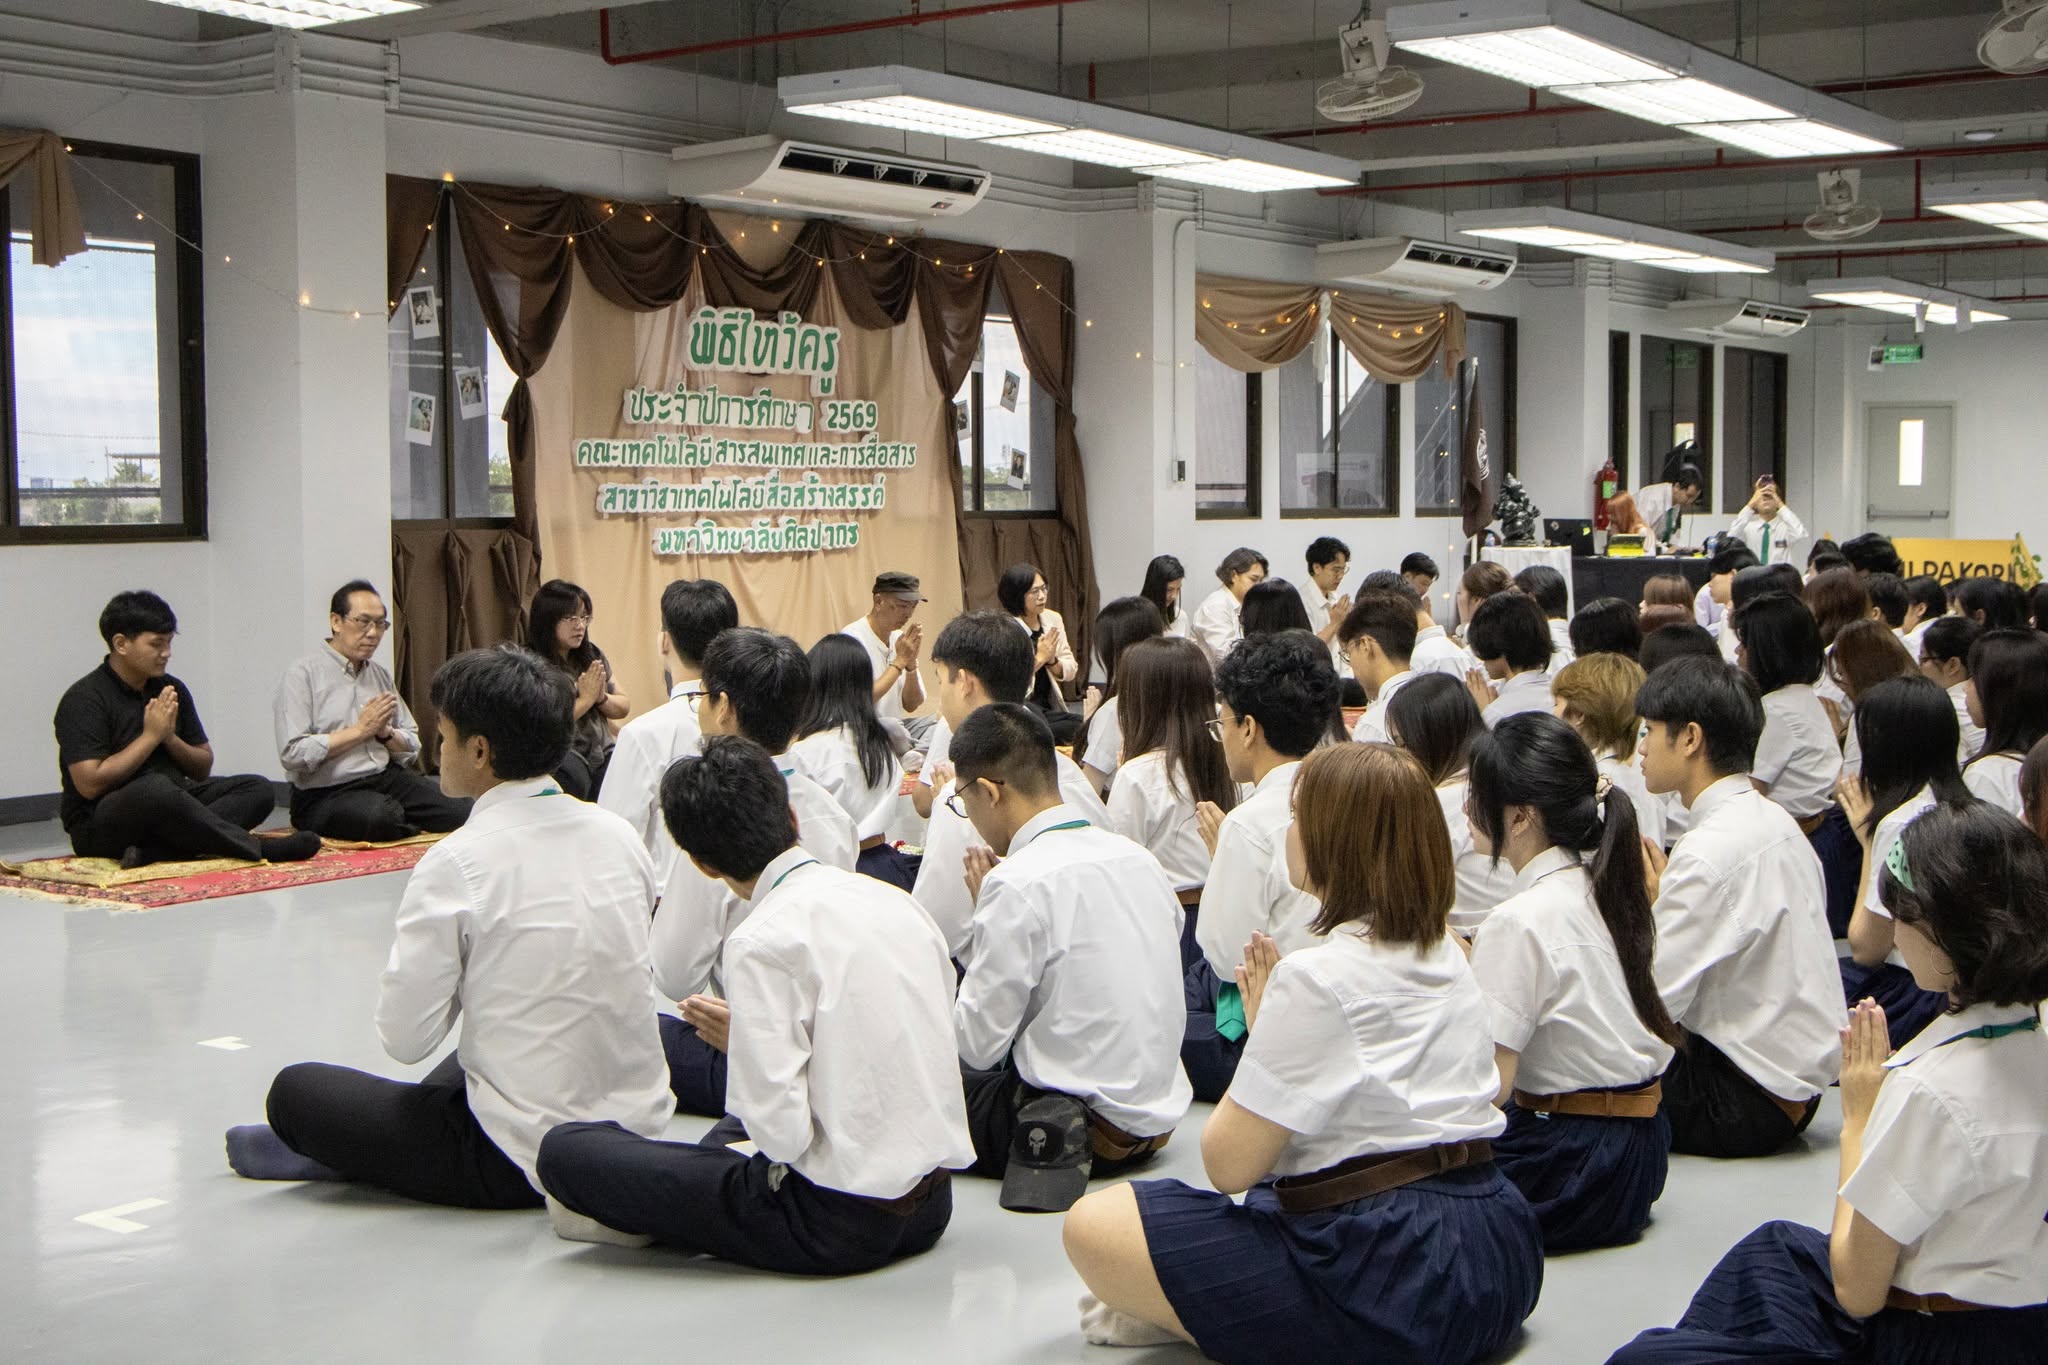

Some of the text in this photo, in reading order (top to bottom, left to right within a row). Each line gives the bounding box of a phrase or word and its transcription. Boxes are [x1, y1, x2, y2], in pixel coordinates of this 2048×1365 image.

[690, 310, 838, 394] พิธีไหว้ครู
[827, 403, 878, 429] 2569
